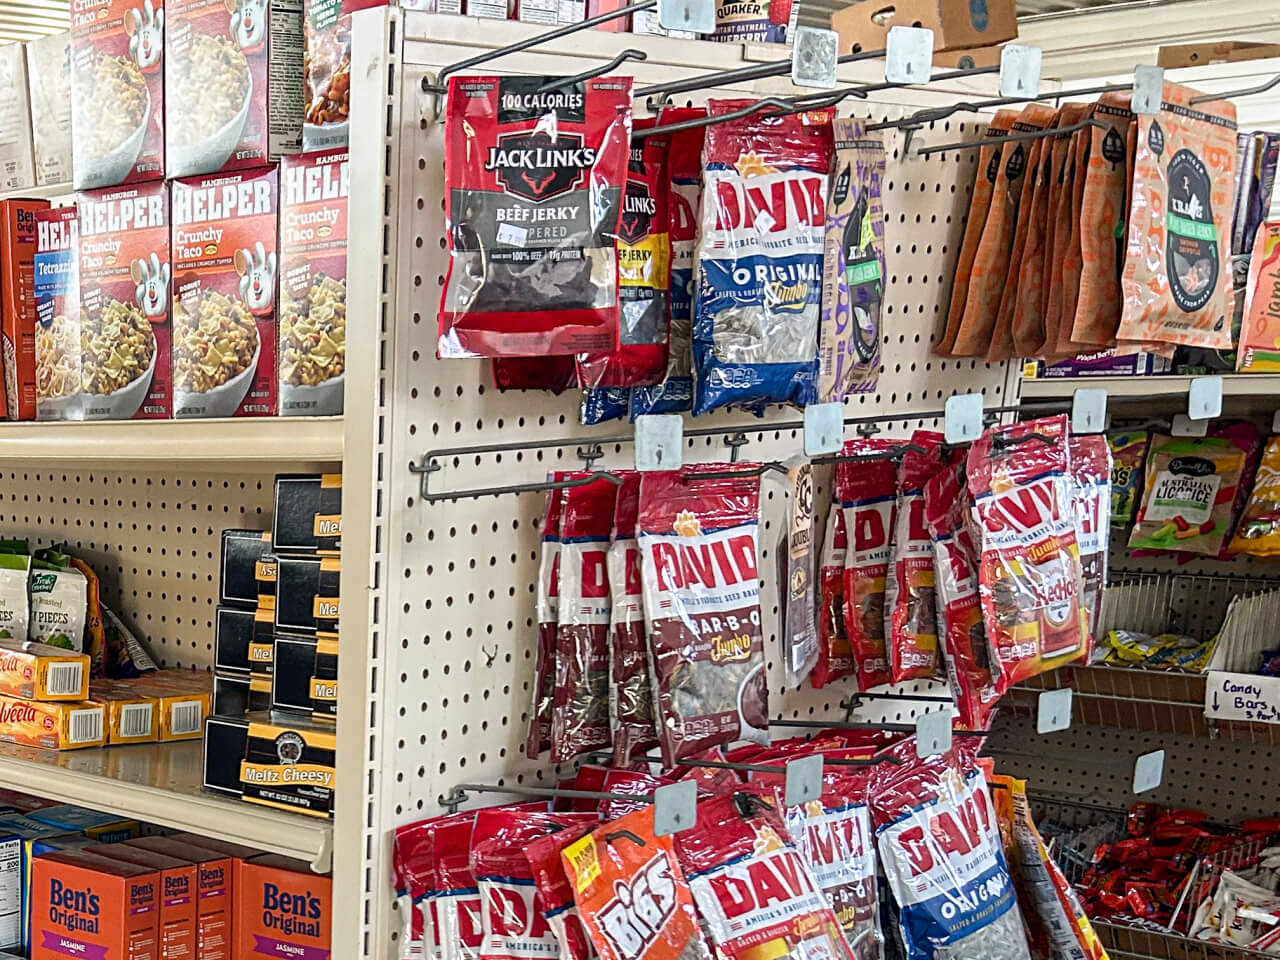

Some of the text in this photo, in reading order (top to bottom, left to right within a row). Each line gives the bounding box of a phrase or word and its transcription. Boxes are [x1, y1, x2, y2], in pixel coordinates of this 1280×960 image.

[717, 4, 761, 19] QUAKER
[737, 23, 767, 32] OATMEAL
[501, 94, 583, 109] 100 CALORIES
[485, 147, 595, 169] JACK LINK'S
[201, 175, 242, 187] HAMBURGER
[102, 190, 137, 200] HAMBURGER
[174, 179, 271, 226] HELPER
[81, 196, 164, 235] HELPER
[286, 207, 339, 230] Crunchy
[496, 206, 580, 223] BEEF JERKY
[176, 227, 224, 247] Crunchy
[286, 224, 313, 241] Taco
[82, 235, 121, 254] Crunchy
[176, 243, 202, 259] Taco
[82, 255, 103, 268] Taco
[733, 264, 821, 285] ORIGINAL
[1245, 347, 1254, 367] NEW
[1161, 480, 1213, 492] AUSTRALIAN
[652, 534, 758, 591] DAVID
[38, 612, 69, 626] PIECES
[711, 633, 751, 661] Jumbo
[1223, 680, 1261, 699] Candy
[1234, 697, 1268, 710] Bars
[1246, 711, 1253, 719] 3
[245, 767, 332, 784] Meltz Cheesy
[7, 860, 20, 869] 200
[165, 875, 189, 889] Ben's
[200, 867, 224, 881] Ben's
[50, 879, 100, 915] Ben's
[130, 883, 153, 897] Ben's
[263, 882, 321, 919] Ben's
[49, 907, 100, 934] Original
[263, 911, 321, 937] Original
[745, 909, 782, 926] AMERICA'S
[60, 940, 86, 953] JASMINE
[275, 943, 305, 957] JASMINE
